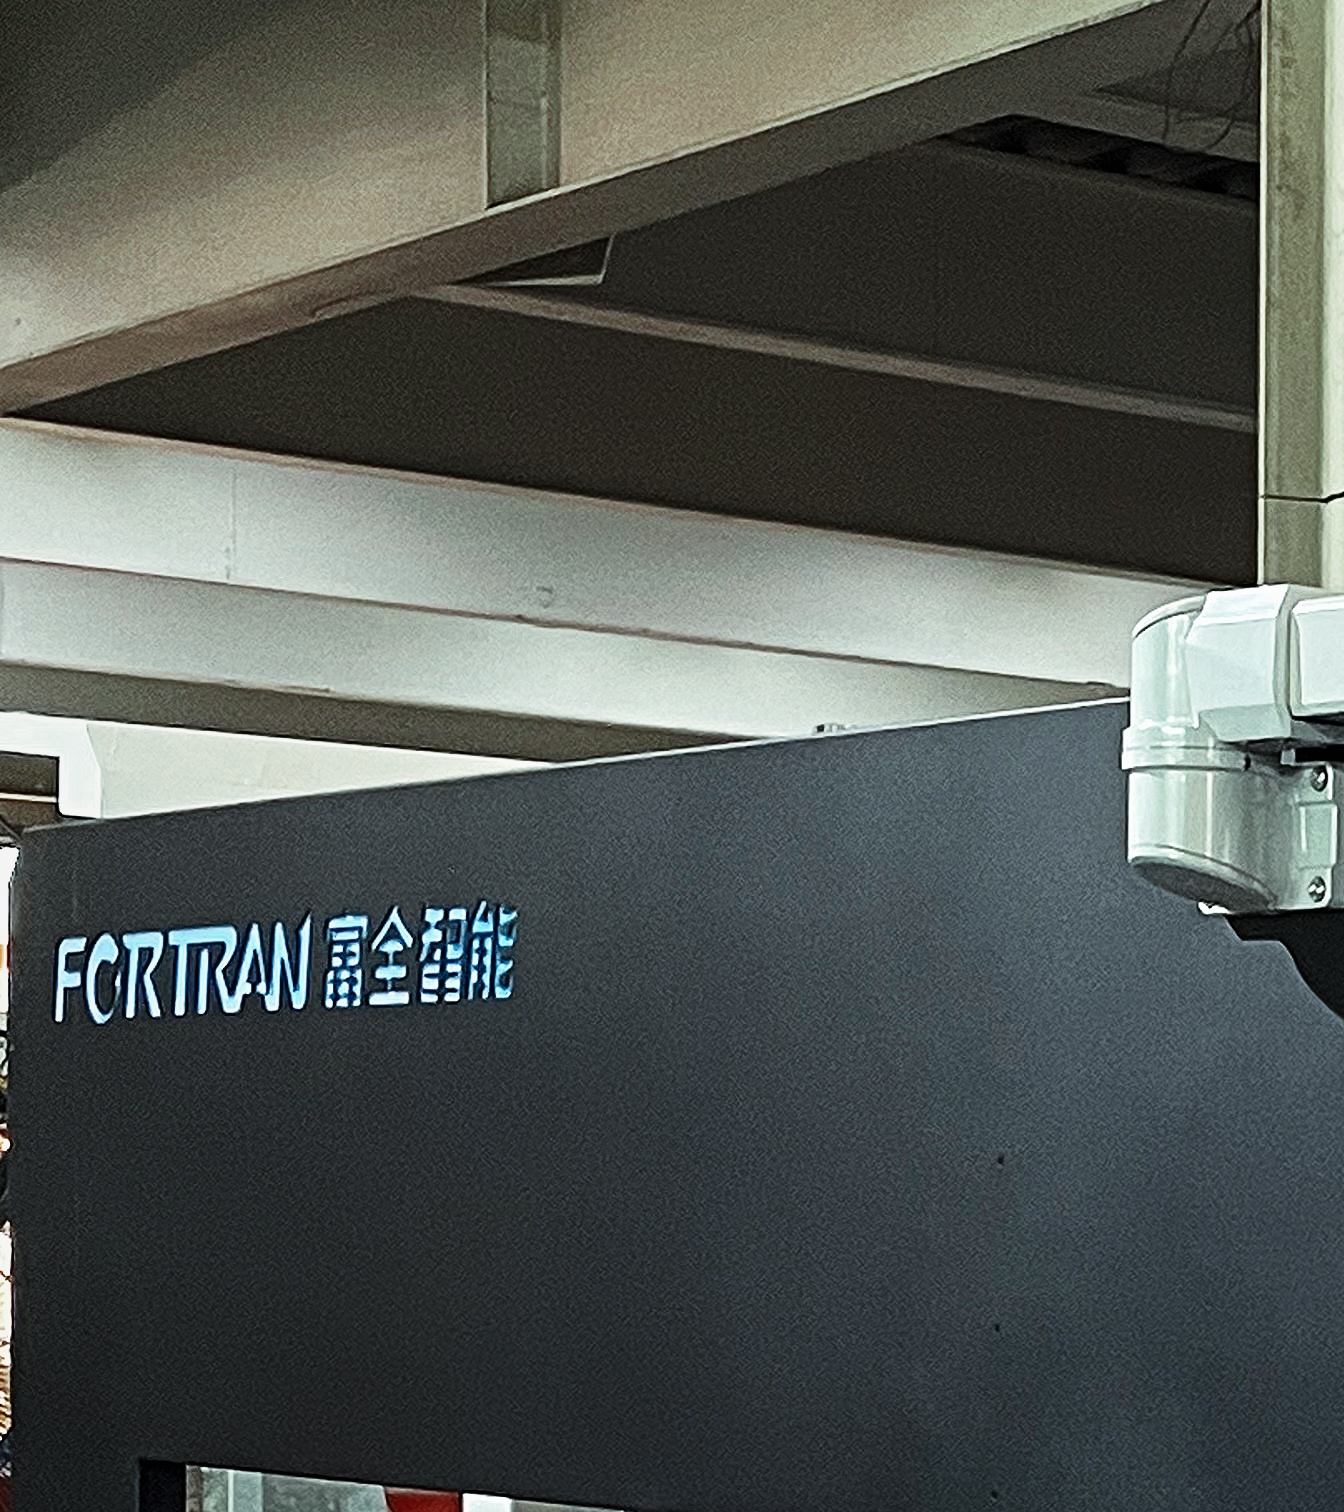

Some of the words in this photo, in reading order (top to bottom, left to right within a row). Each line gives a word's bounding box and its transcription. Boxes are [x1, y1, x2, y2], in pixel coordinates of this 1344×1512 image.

[53, 911, 313, 1025] FORTRAN
[325, 900, 518, 1010] 富全智能
